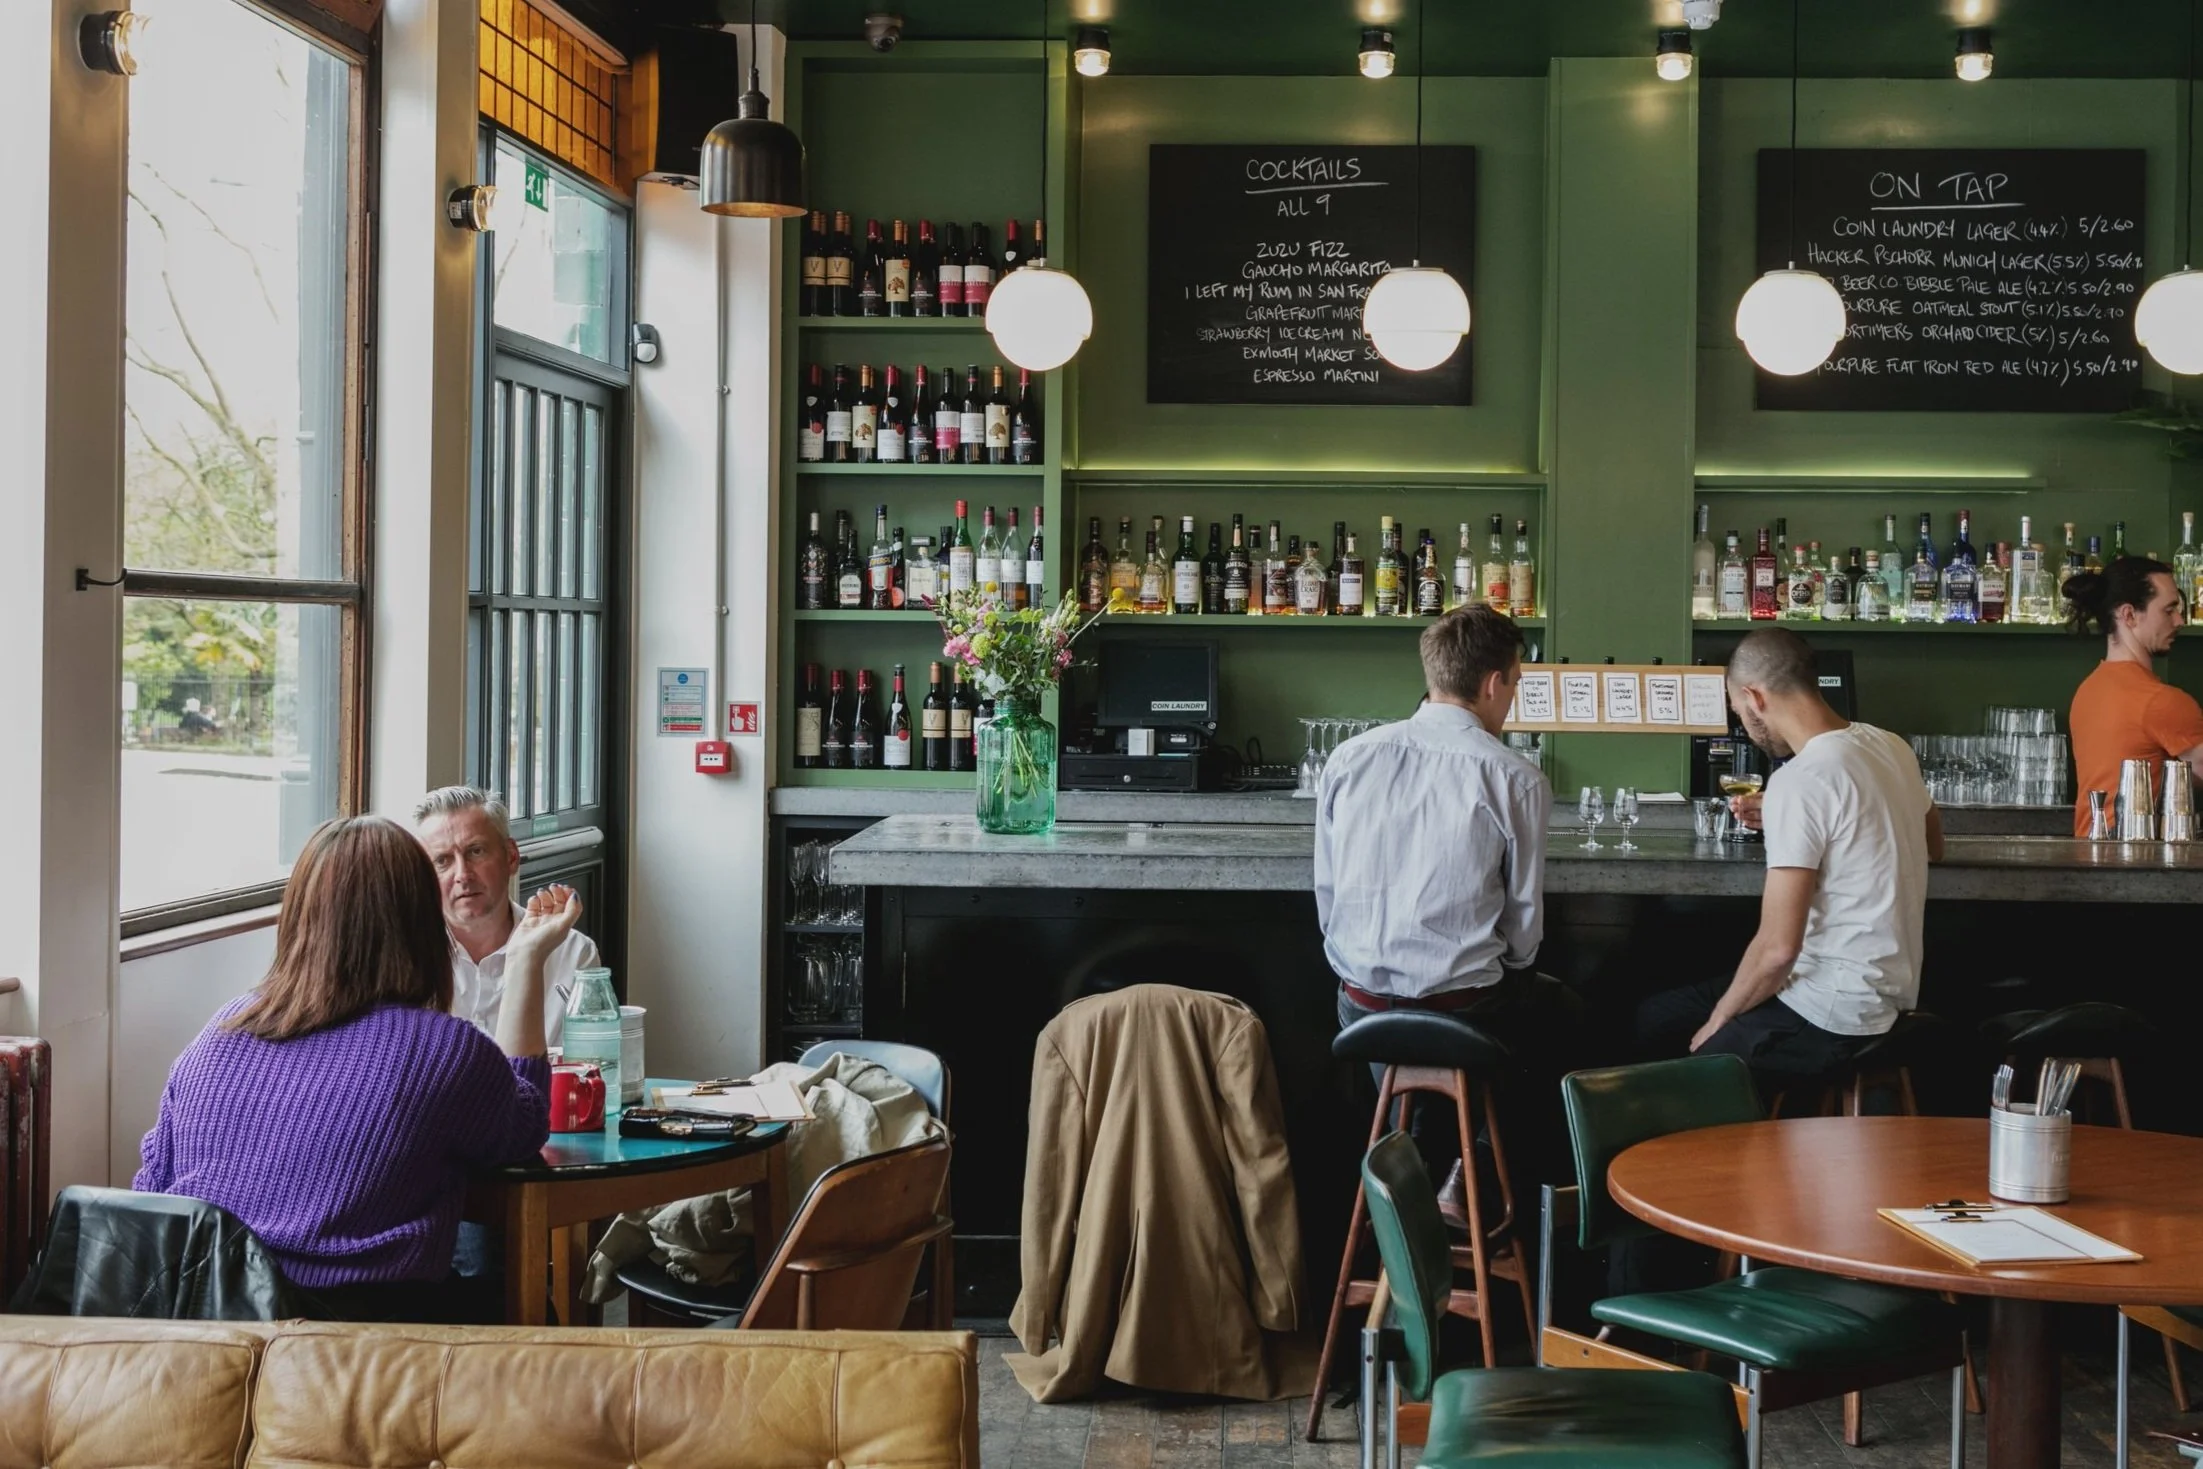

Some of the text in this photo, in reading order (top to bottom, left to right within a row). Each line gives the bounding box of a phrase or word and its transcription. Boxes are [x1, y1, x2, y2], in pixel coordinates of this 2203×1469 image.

[1246, 157, 1361, 182] COCKTAILS
[1870, 171, 2008, 202] ON TAP
[1277, 193, 1331, 216] ALL 9
[1833, 216, 1876, 236] COIN
[1882, 219, 1956, 239] LAUNDRY
[1967, 220, 2021, 241] LAGER
[1306, 240, 1351, 257] FIZZ
[1808, 241, 1870, 266] HACKER
[1874, 244, 1936, 265] PSCHORR
[1943, 250, 1996, 275] MUNICH
[2001, 252, 2049, 273] LAGER
[1242, 260, 1391, 279] GAUCHO MARGARITA
[1196, 283, 1228, 299] LEFT
[1233, 283, 1253, 301] MY
[1258, 282, 1292, 300] RUM
[1298, 287, 1313, 298] IN
[1318, 284, 1345, 299] SAN
[1842, 275, 1876, 291] BEER
[1906, 276, 1955, 293] BIBBLE
[1957, 276, 1991, 295] PALE
[1998, 281, 2023, 295] ALE
[1246, 304, 1332, 321] GRAPEFRUIT
[1844, 297, 1903, 316] OURPURE
[1912, 300, 1974, 317] OATMEAL
[1979, 301, 2021, 316] STOUT
[1196, 328, 1271, 345] STRAWBERRY
[1845, 323, 1914, 341] ORTIMERS
[1921, 324, 1974, 344] ORCHARD
[1975, 324, 2024, 345] CIDER
[1243, 347, 1299, 364] EXMOUTH
[1305, 346, 1356, 362] MARKET
[1253, 368, 1379, 384] ESPRESSO MARTINI
[1817, 357, 1880, 376] OURPURE
[1886, 357, 1920, 375] FLAT
[1923, 359, 1959, 374] IRON
[1963, 360, 1995, 375] RED
[2001, 359, 2022, 375] ALE
